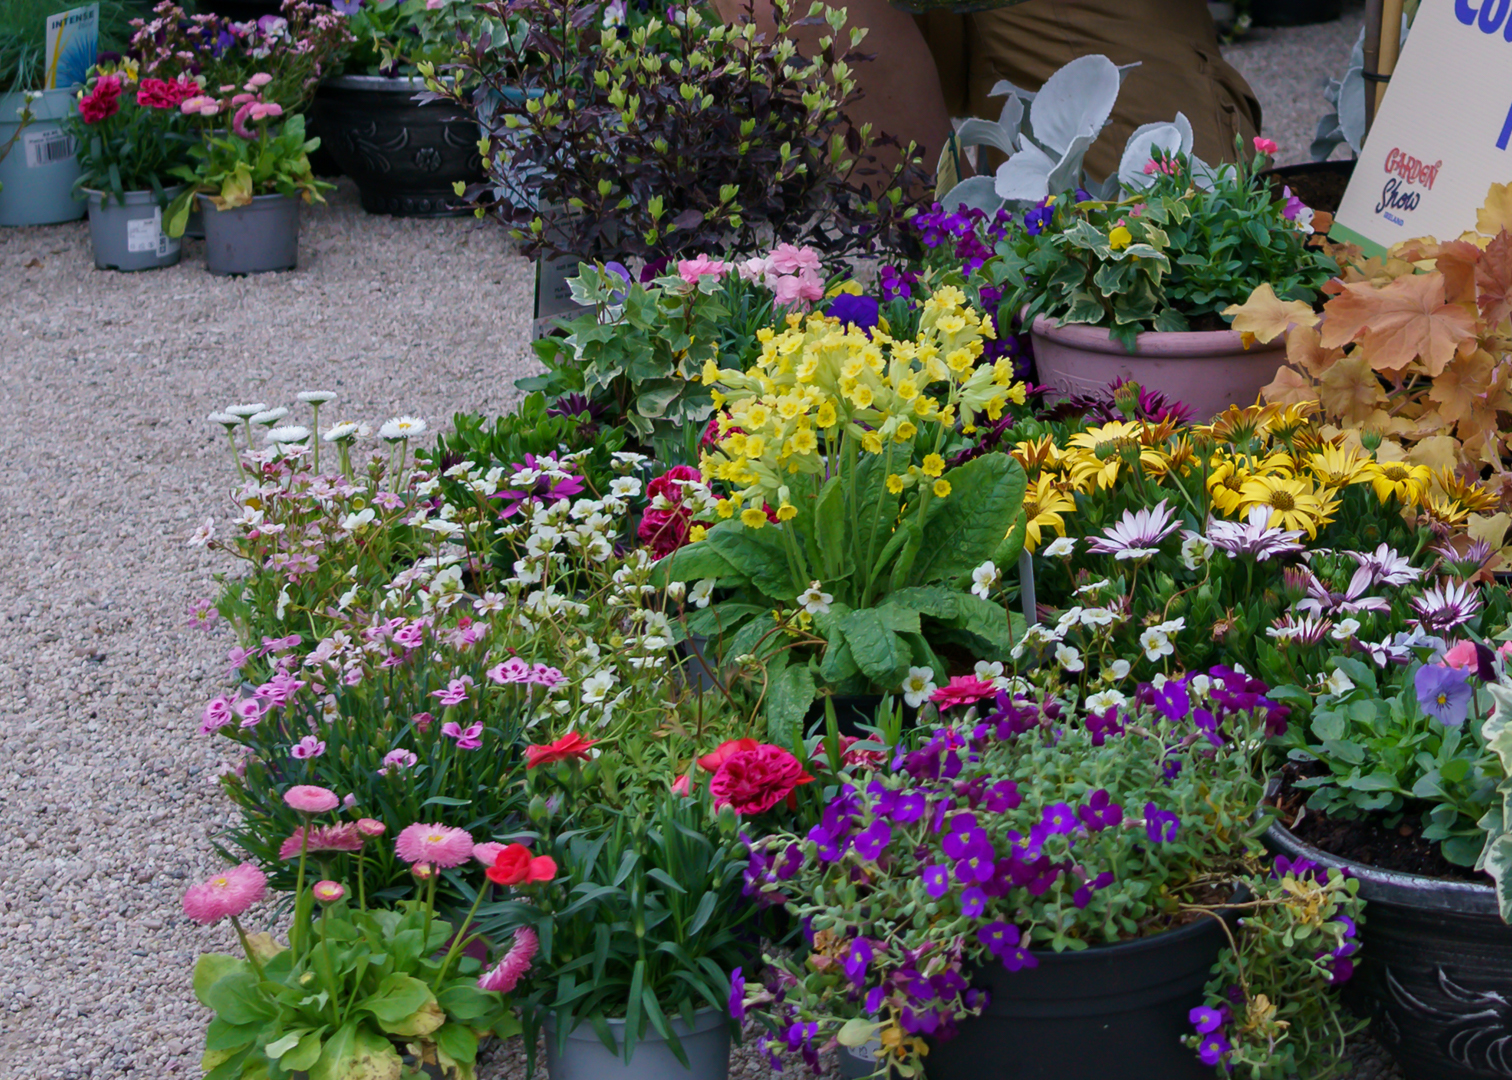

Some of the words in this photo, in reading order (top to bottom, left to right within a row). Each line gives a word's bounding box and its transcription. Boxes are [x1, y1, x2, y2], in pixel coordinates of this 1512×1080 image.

[52, 10, 94, 30] INTENSE
[1384, 147, 1442, 190] GARDEN
[1375, 178, 1420, 214] Show
